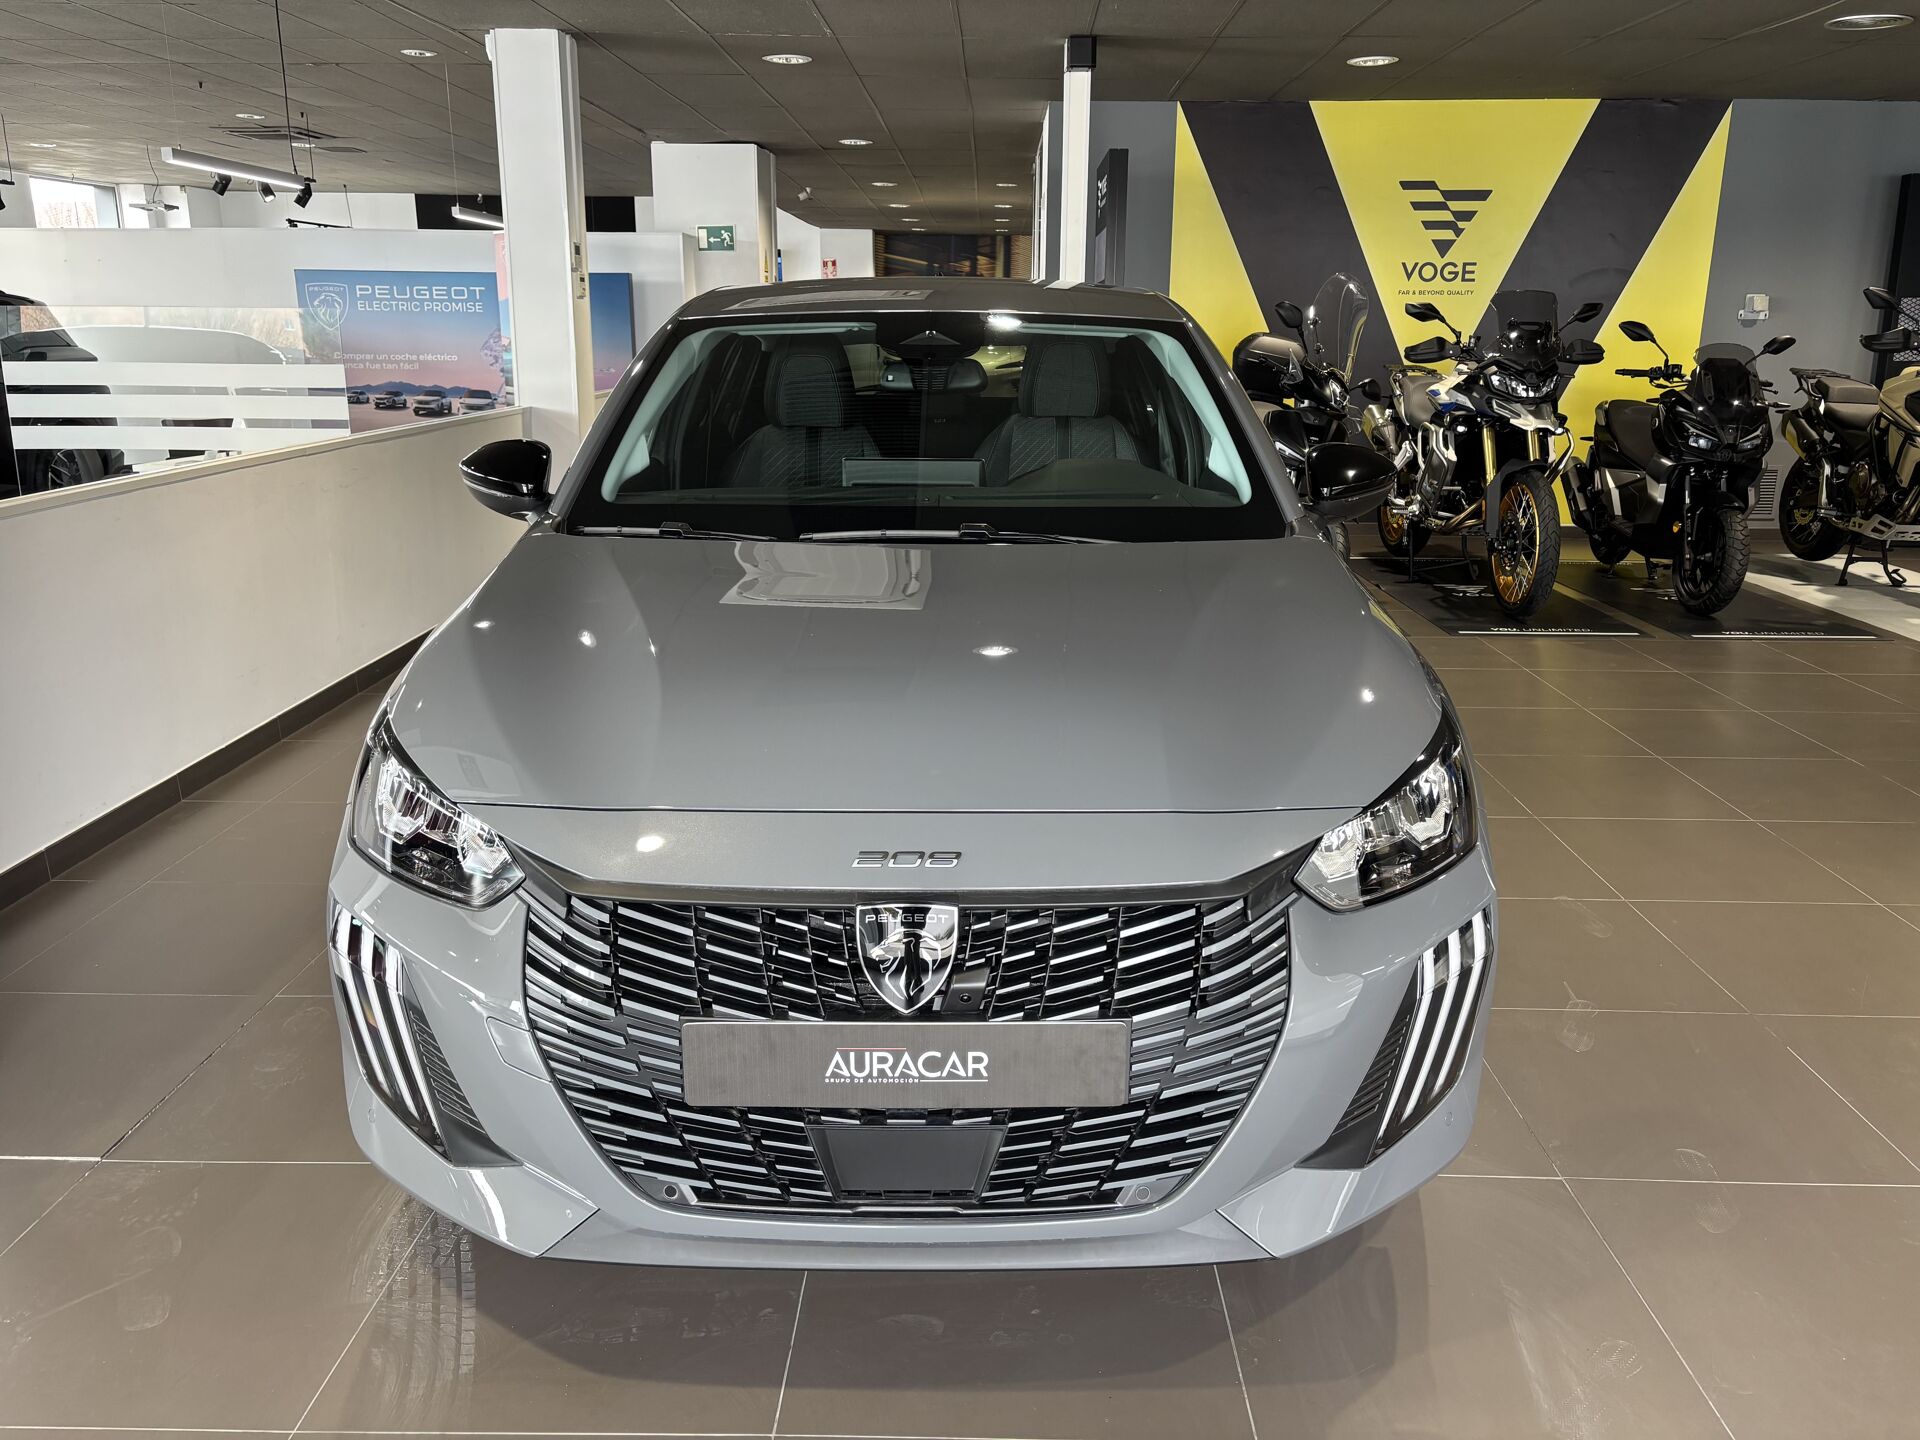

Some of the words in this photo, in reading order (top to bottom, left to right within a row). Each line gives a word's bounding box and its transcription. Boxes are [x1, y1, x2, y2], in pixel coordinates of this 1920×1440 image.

[1401, 262, 1477, 283] VOGE
[355, 285, 486, 300] PEUGEOT
[357, 300, 421, 312] ELECTRIC
[424, 301, 483, 313] PROMISE
[390, 352, 417, 361] coche
[419, 352, 458, 361] eléctrico
[383, 362, 398, 370] tan
[400, 362, 419, 370] fácil
[851, 850, 963, 869] 208
[865, 913, 949, 924] PEUGEOT
[824, 1050, 989, 1078] AURACAR
